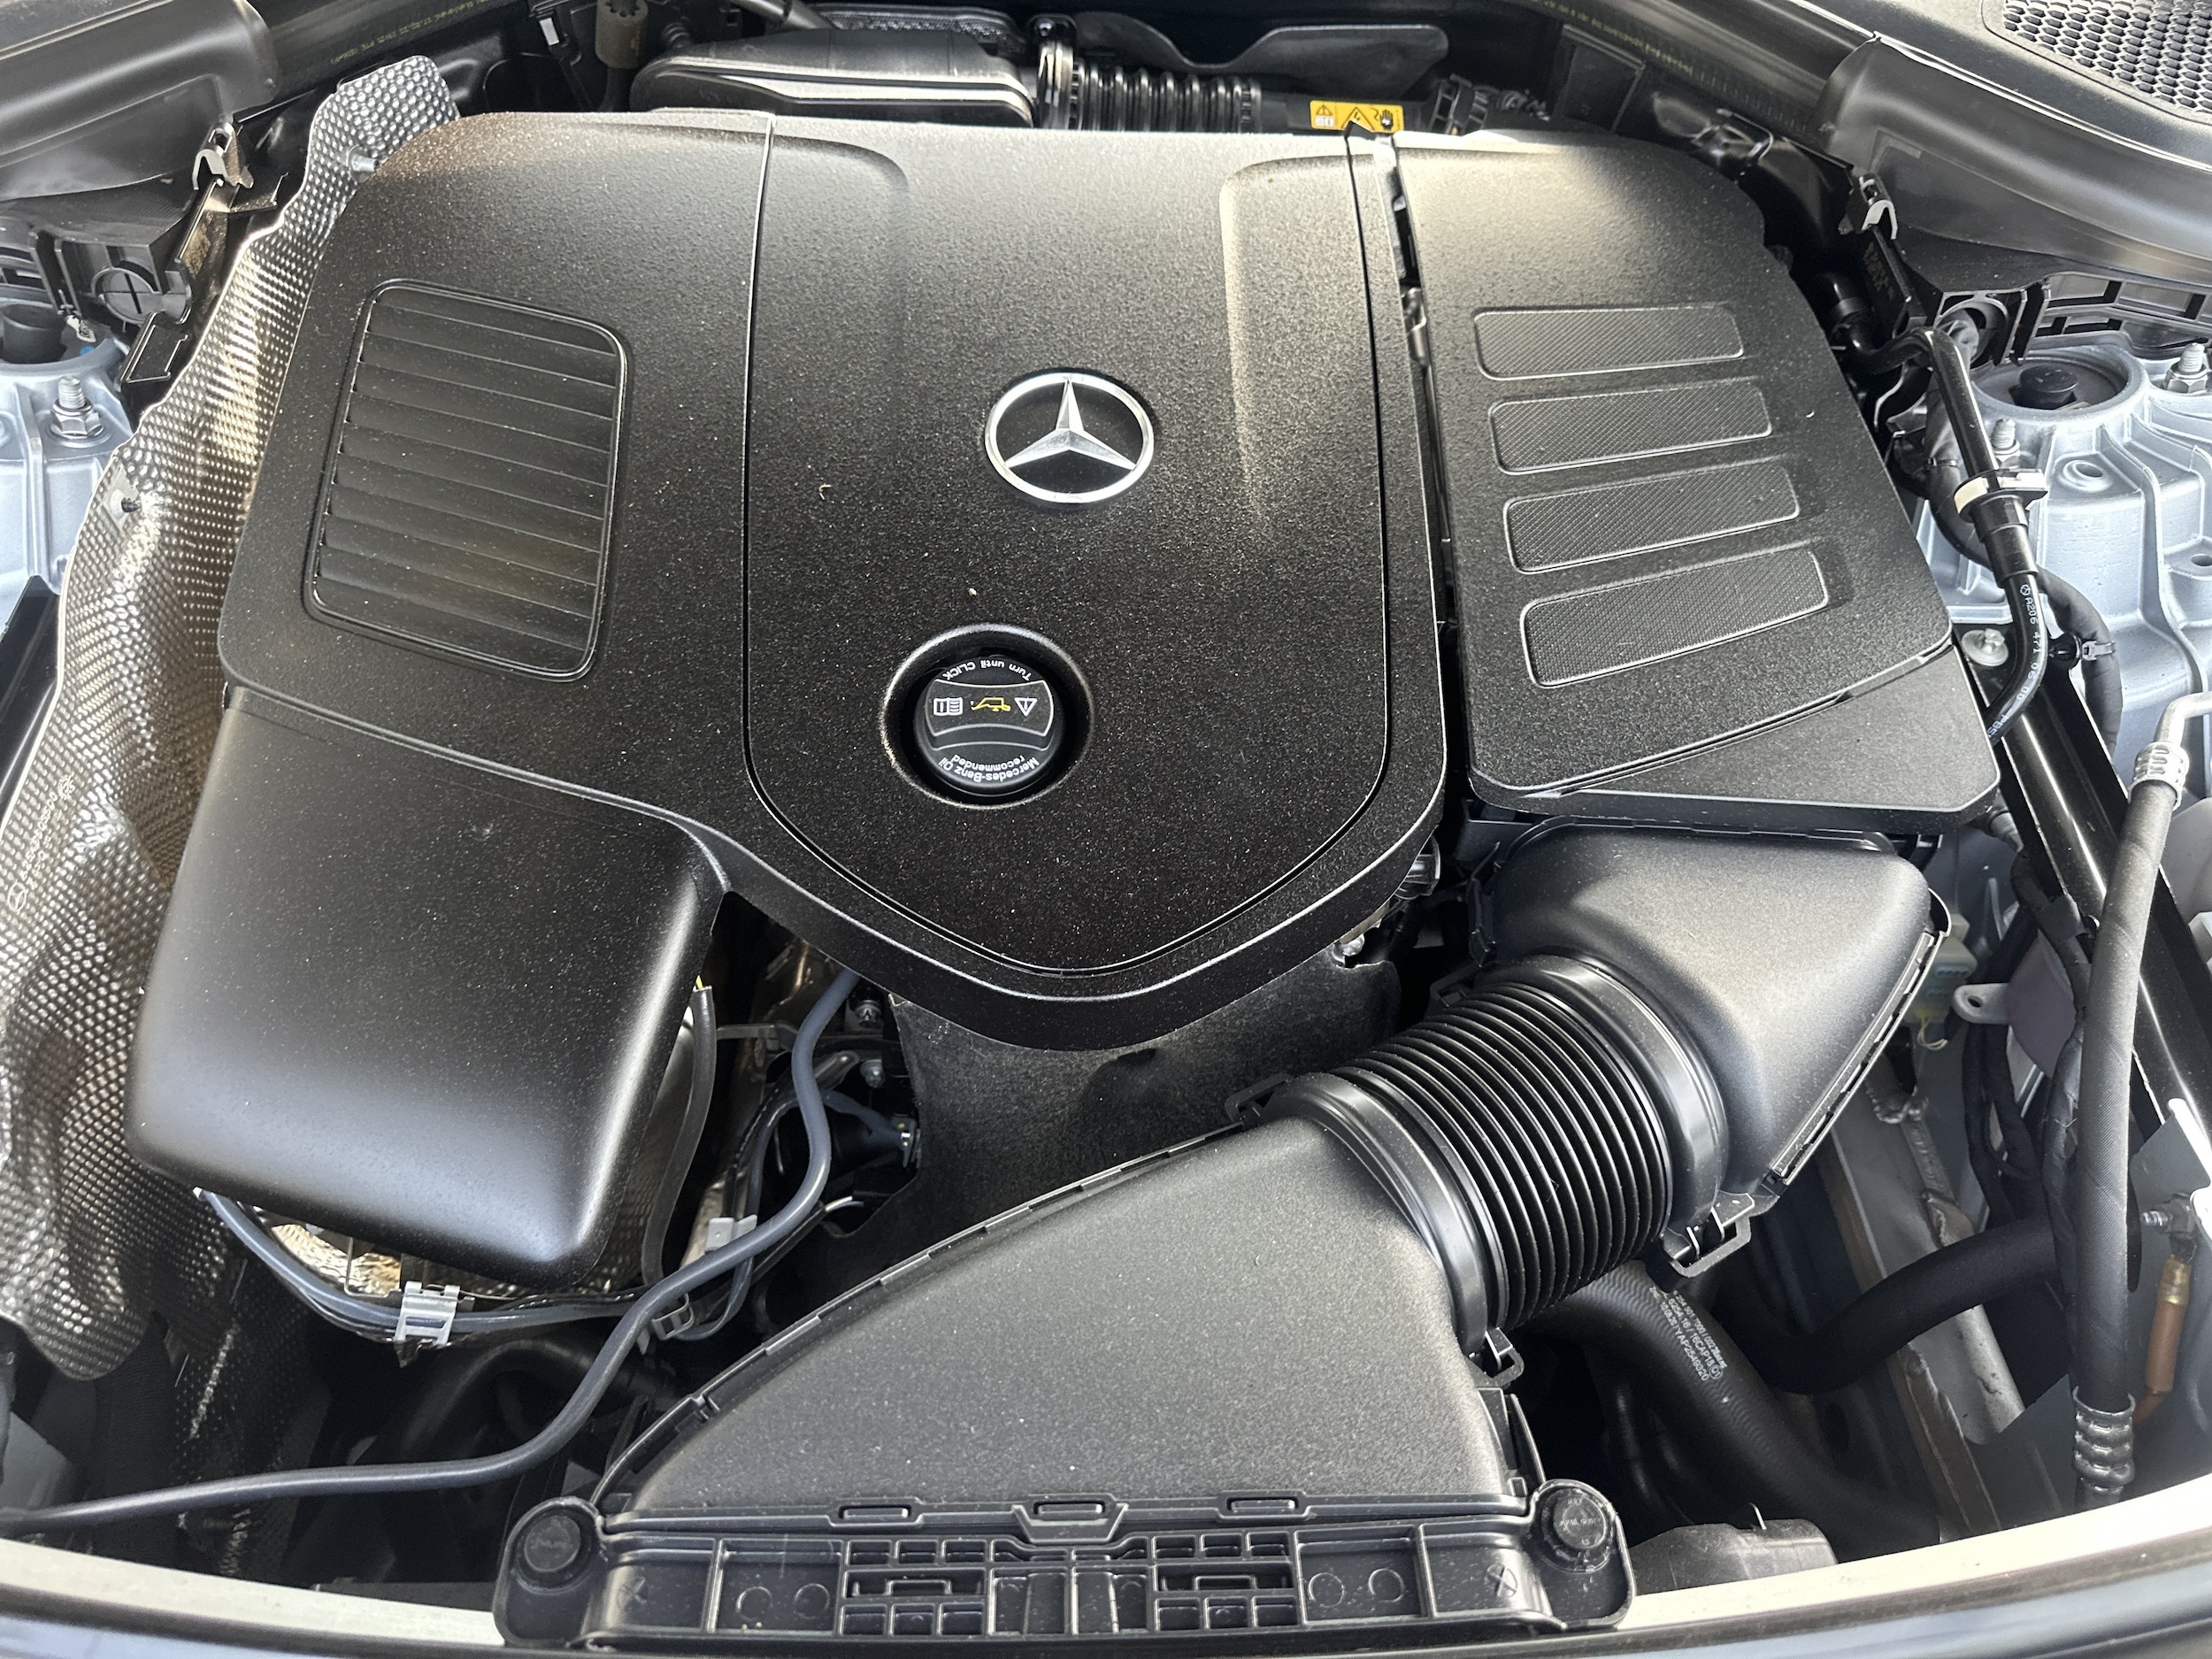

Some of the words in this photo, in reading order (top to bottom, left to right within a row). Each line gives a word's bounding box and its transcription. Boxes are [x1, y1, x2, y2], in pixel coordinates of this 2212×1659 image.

[2024, 596, 2039, 625] A206
[2032, 631, 2041, 654] 471
[941, 661, 975, 681] CLICK
[980, 659, 1005, 669] until
[1009, 663, 1033, 681] Turn
[2016, 686, 2030, 701] 00
[938, 757, 954, 772] Oil
[950, 754, 1026, 772] recommended
[954, 757, 1041, 783] Mercedes-Benz
[1675, 1294, 1687, 1307] 254
[1684, 1306, 1695, 1317] 501
[1694, 1317, 1707, 1334] 7000
[1675, 1327, 1709, 1381] YAP2549320
[1690, 1333, 1715, 1367] 16CAP18
